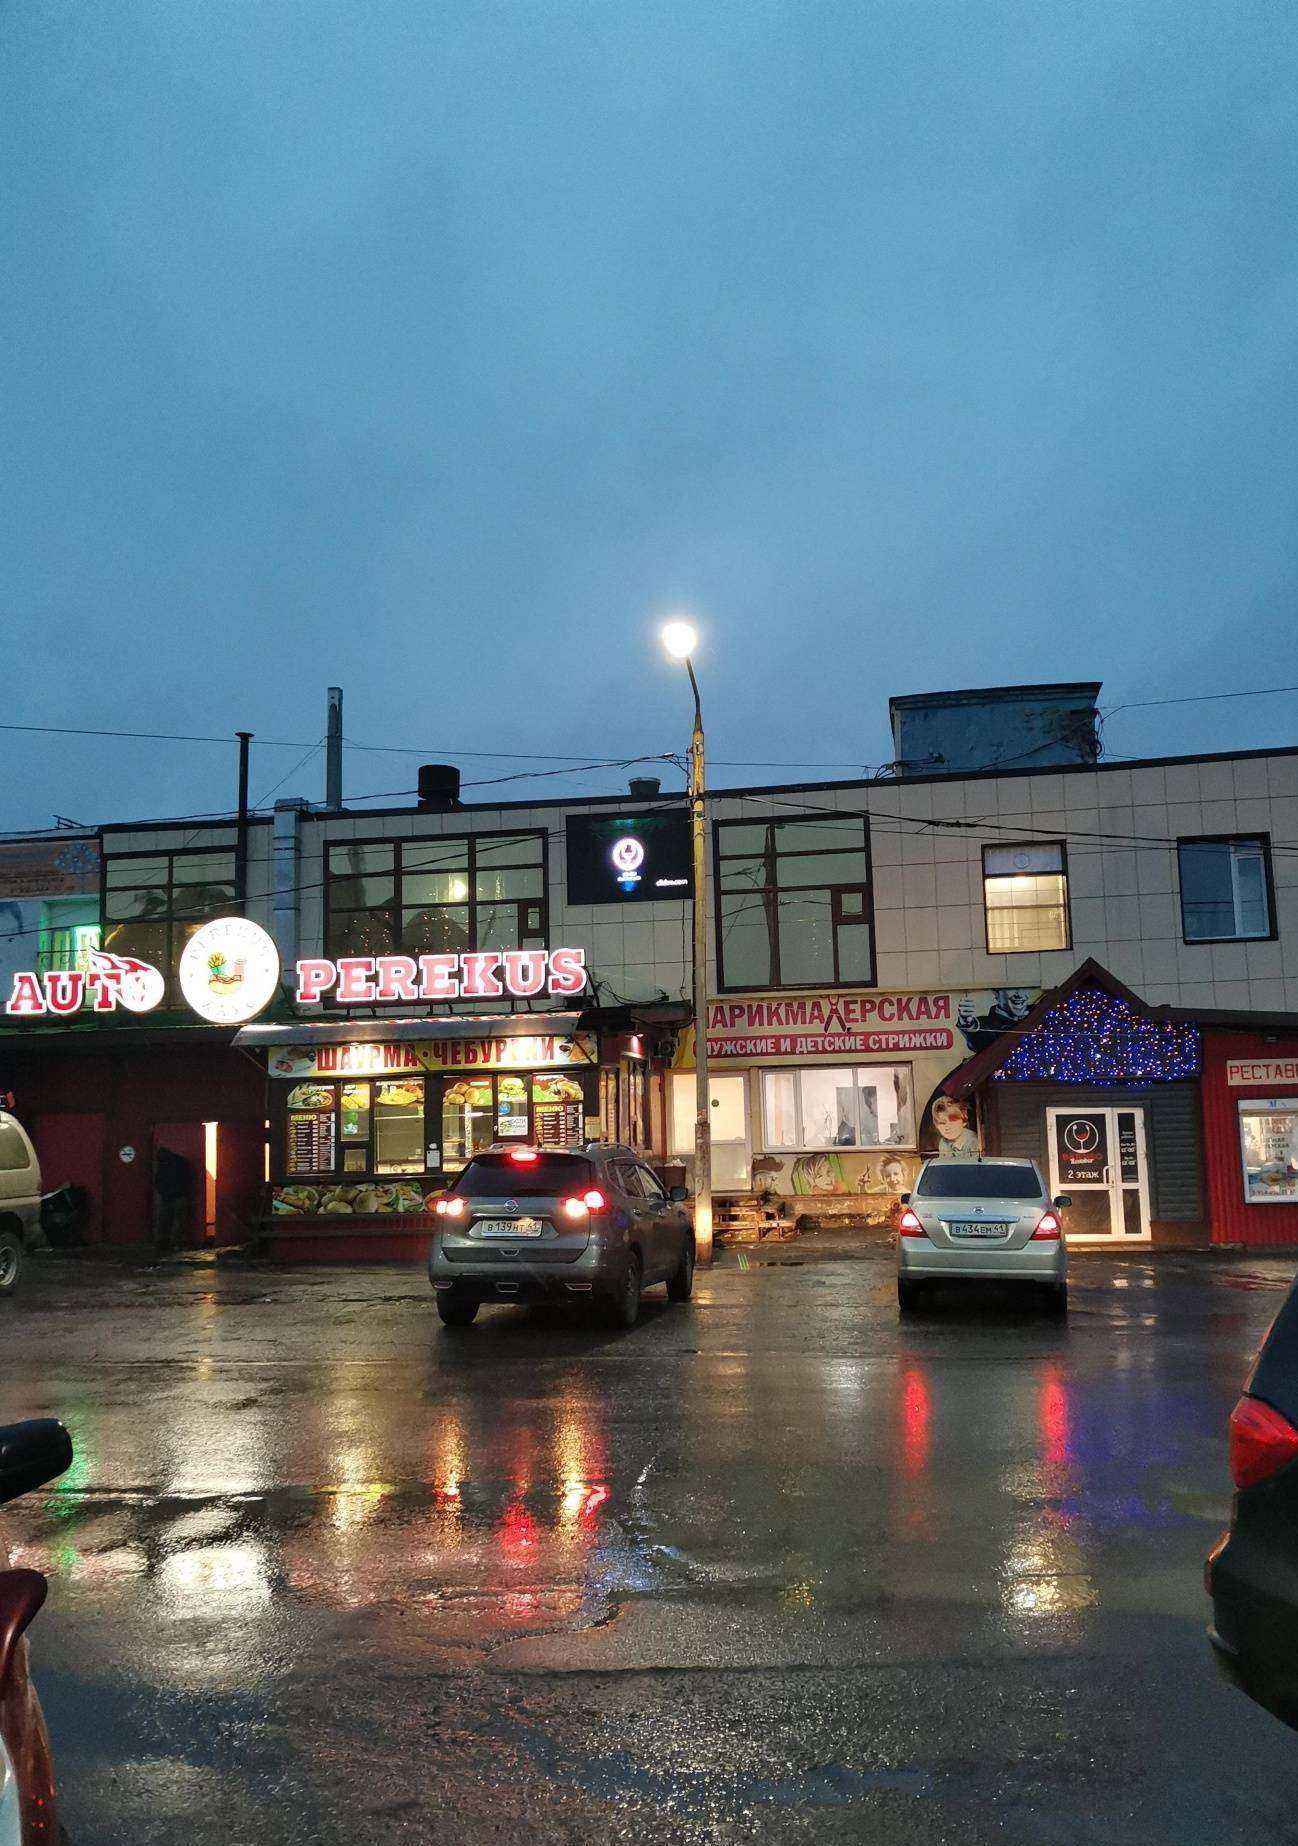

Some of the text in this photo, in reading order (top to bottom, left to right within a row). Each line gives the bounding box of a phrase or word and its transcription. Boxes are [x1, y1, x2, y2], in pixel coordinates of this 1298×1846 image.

[297, 949, 587, 1002] PEREKUS
[433, 1037, 555, 1065] ЧЕБУРИ
[780, 1037, 792, 1052] И
[796, 1034, 865, 1054] ДЕТСКИЕ
[868, 1032, 948, 1050] СТРИЖКИ
[1230, 1063, 1298, 1080] РЕСТАВ
[1067, 1169, 1100, 1179] 2 этаж
